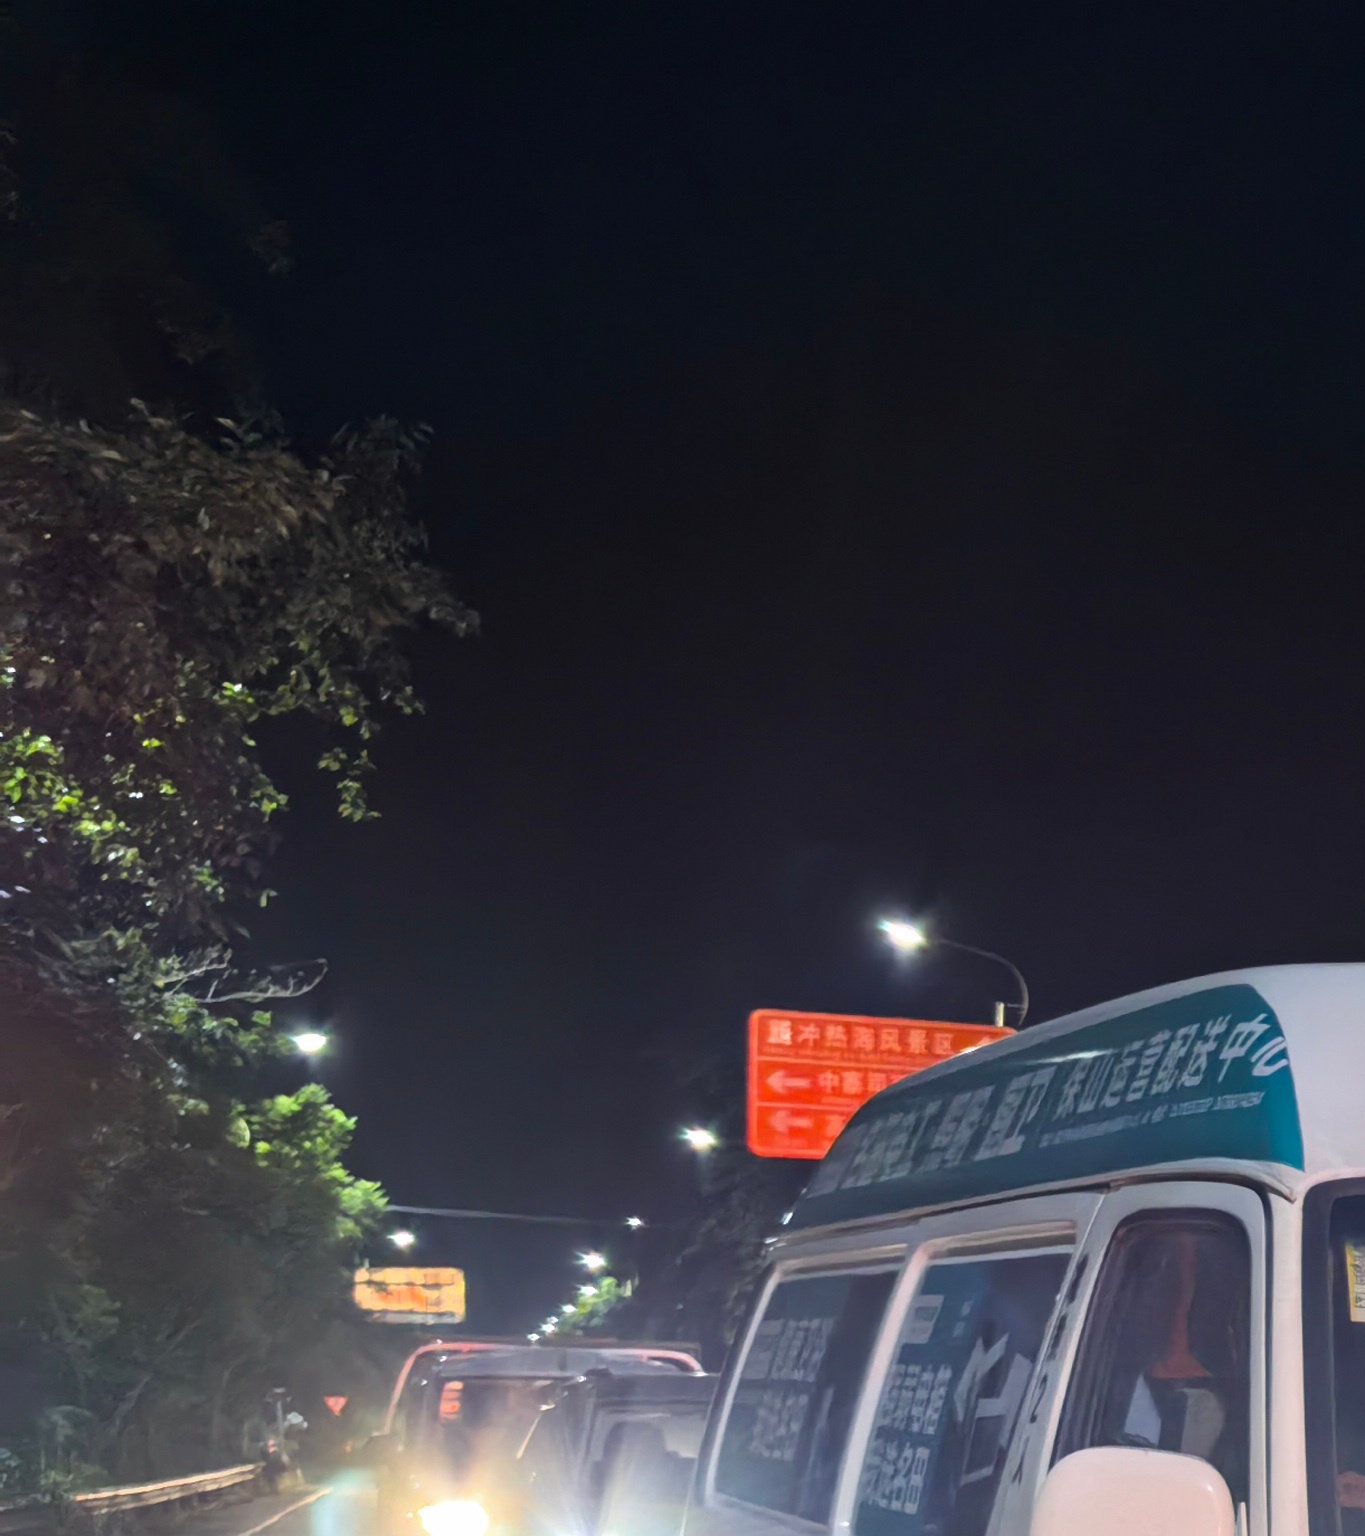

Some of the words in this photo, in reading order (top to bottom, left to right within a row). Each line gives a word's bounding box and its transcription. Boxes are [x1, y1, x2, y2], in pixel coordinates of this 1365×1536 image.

[768, 1019, 954, 1055] 腾冲热海风景区
